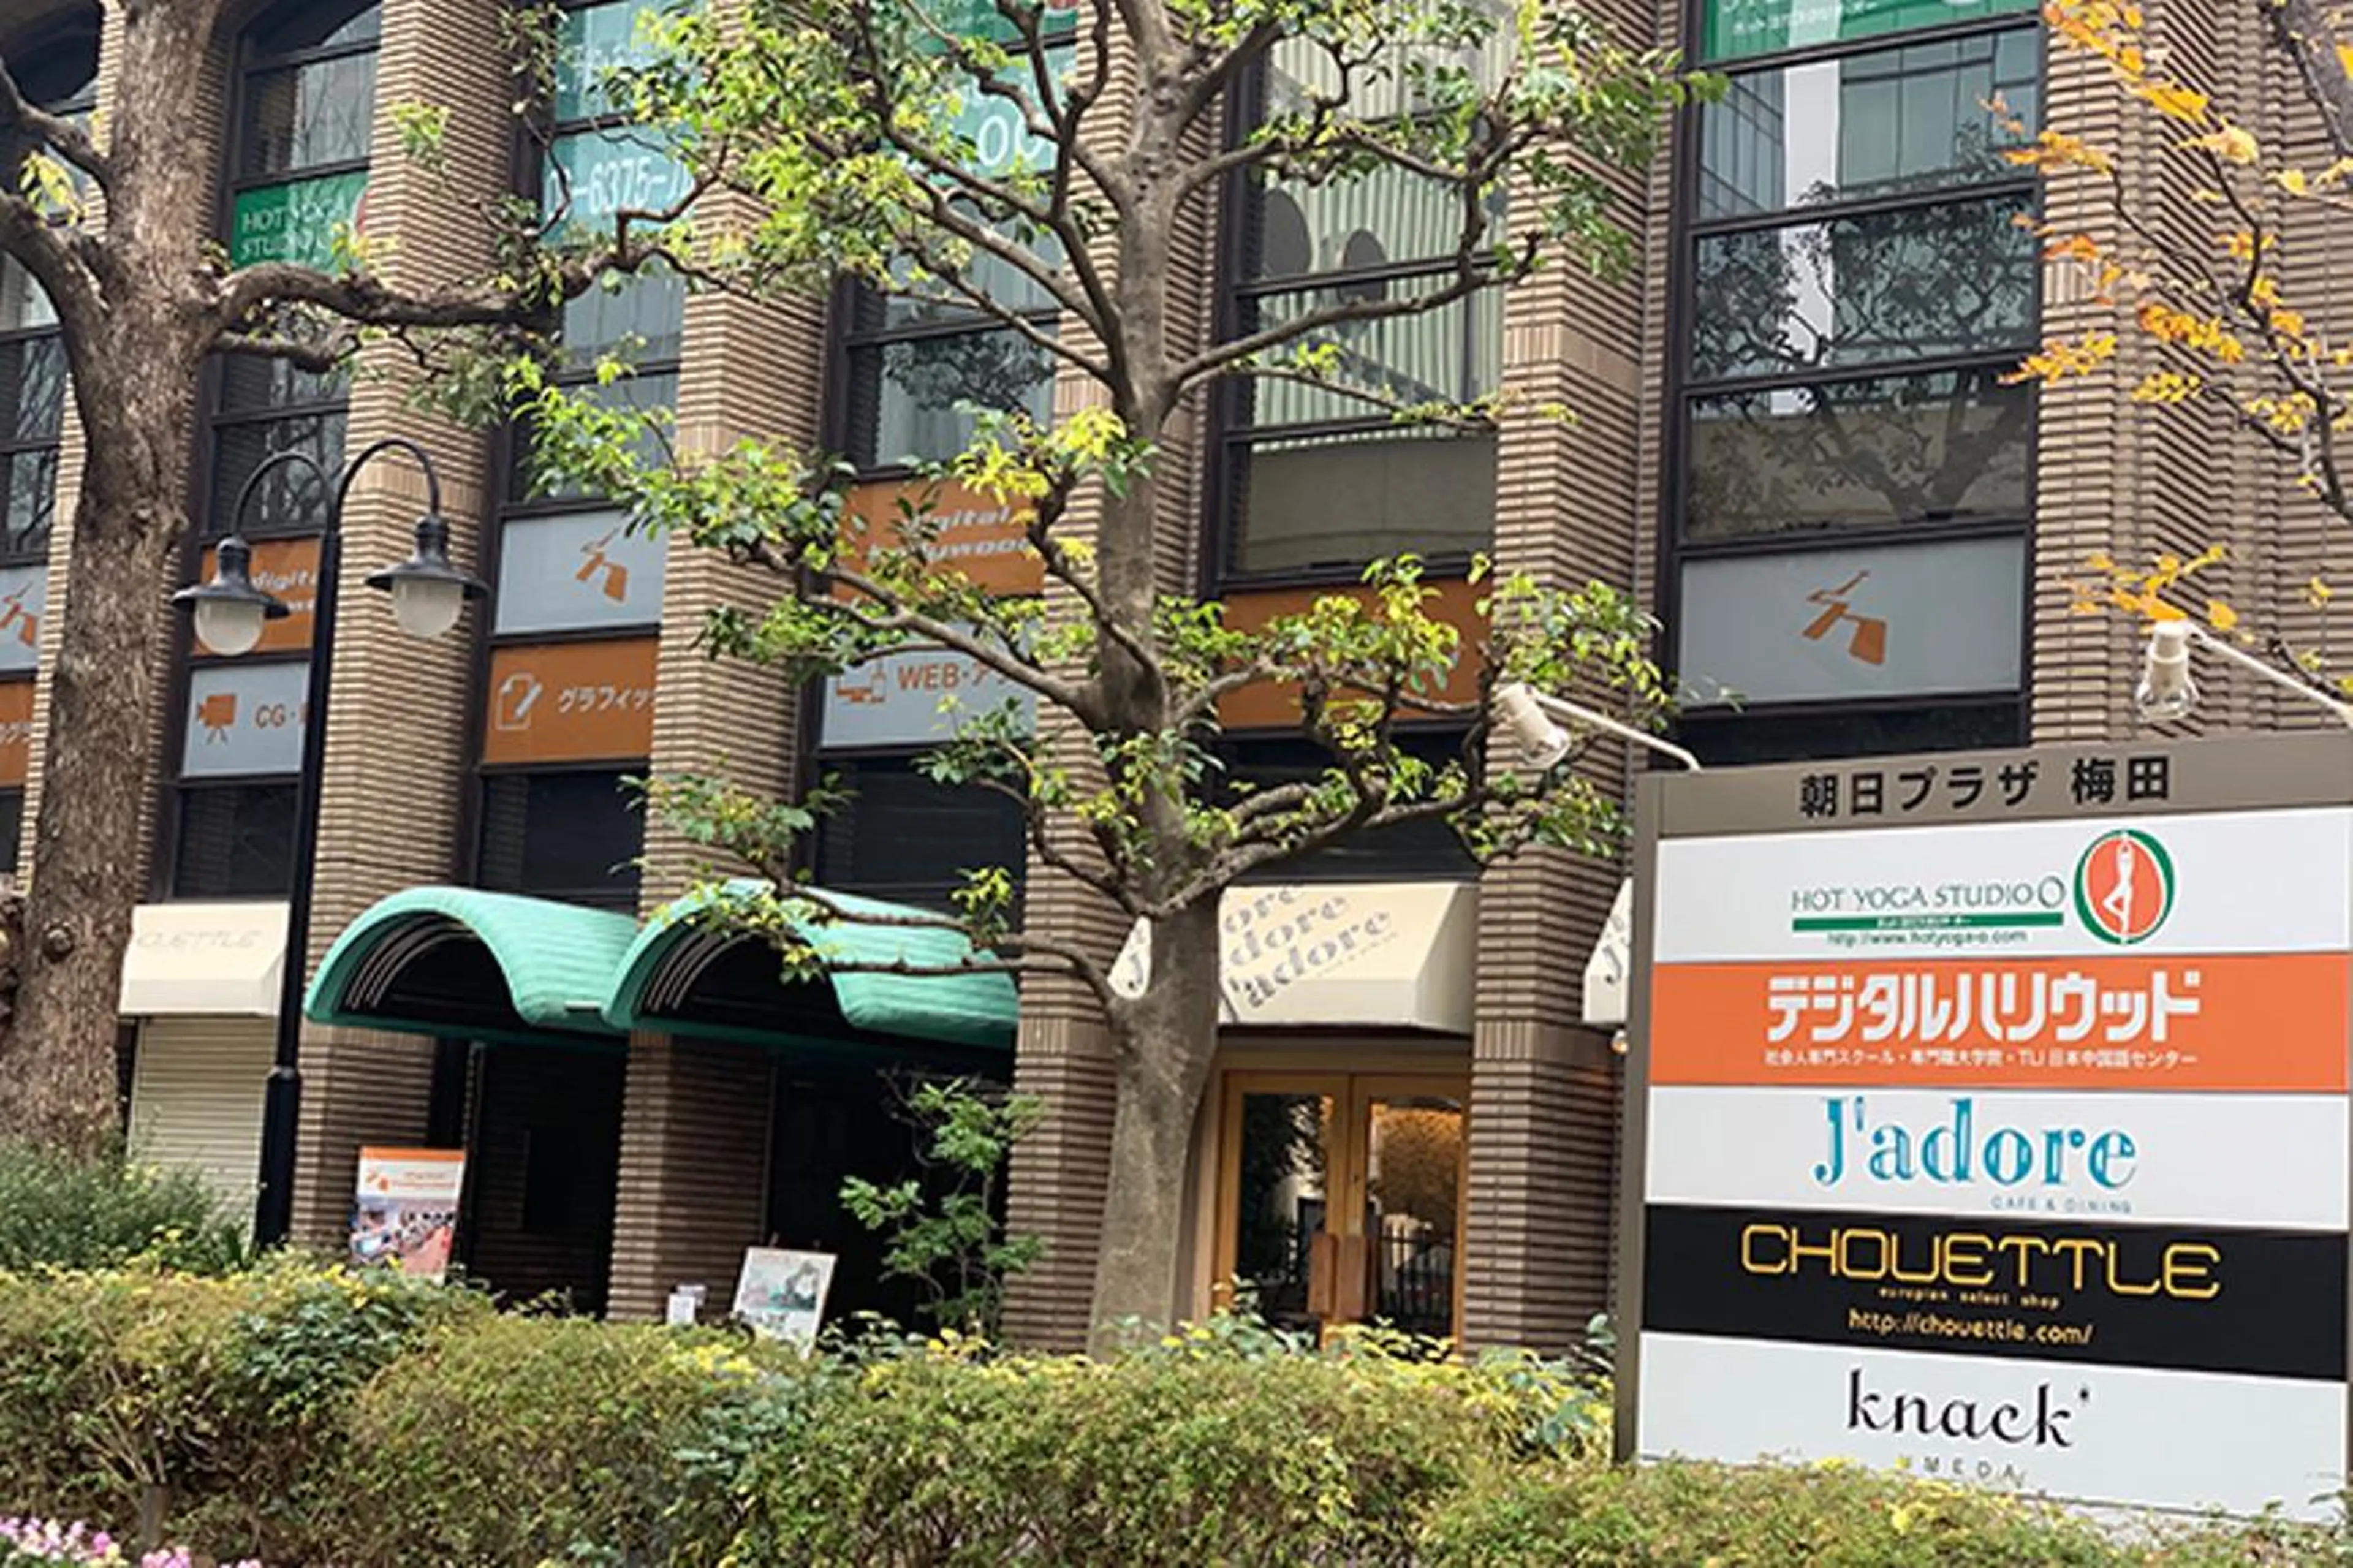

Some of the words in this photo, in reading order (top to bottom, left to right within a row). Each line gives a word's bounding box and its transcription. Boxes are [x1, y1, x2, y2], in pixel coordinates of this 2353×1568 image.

[241, 206, 284, 232] HOT
[1800, 760, 2039, 818] 朝日プラザ
[2071, 756, 2170, 805] 梅田
[1792, 888, 1843, 912] HOT
[1853, 885, 1928, 910] YOGA
[1767, 971, 2200, 1042] デジタルハリウッド
[1812, 1096, 2139, 1189] J'adore
[1990, 1195, 2037, 1211] CAFE
[2063, 1197, 2132, 1215] DINING
[1741, 1224, 2222, 1299] CHOUETTLE
[1847, 1307, 2094, 1344] http://chouettle.com/
[1896, 1455, 2016, 1479] MEDA
